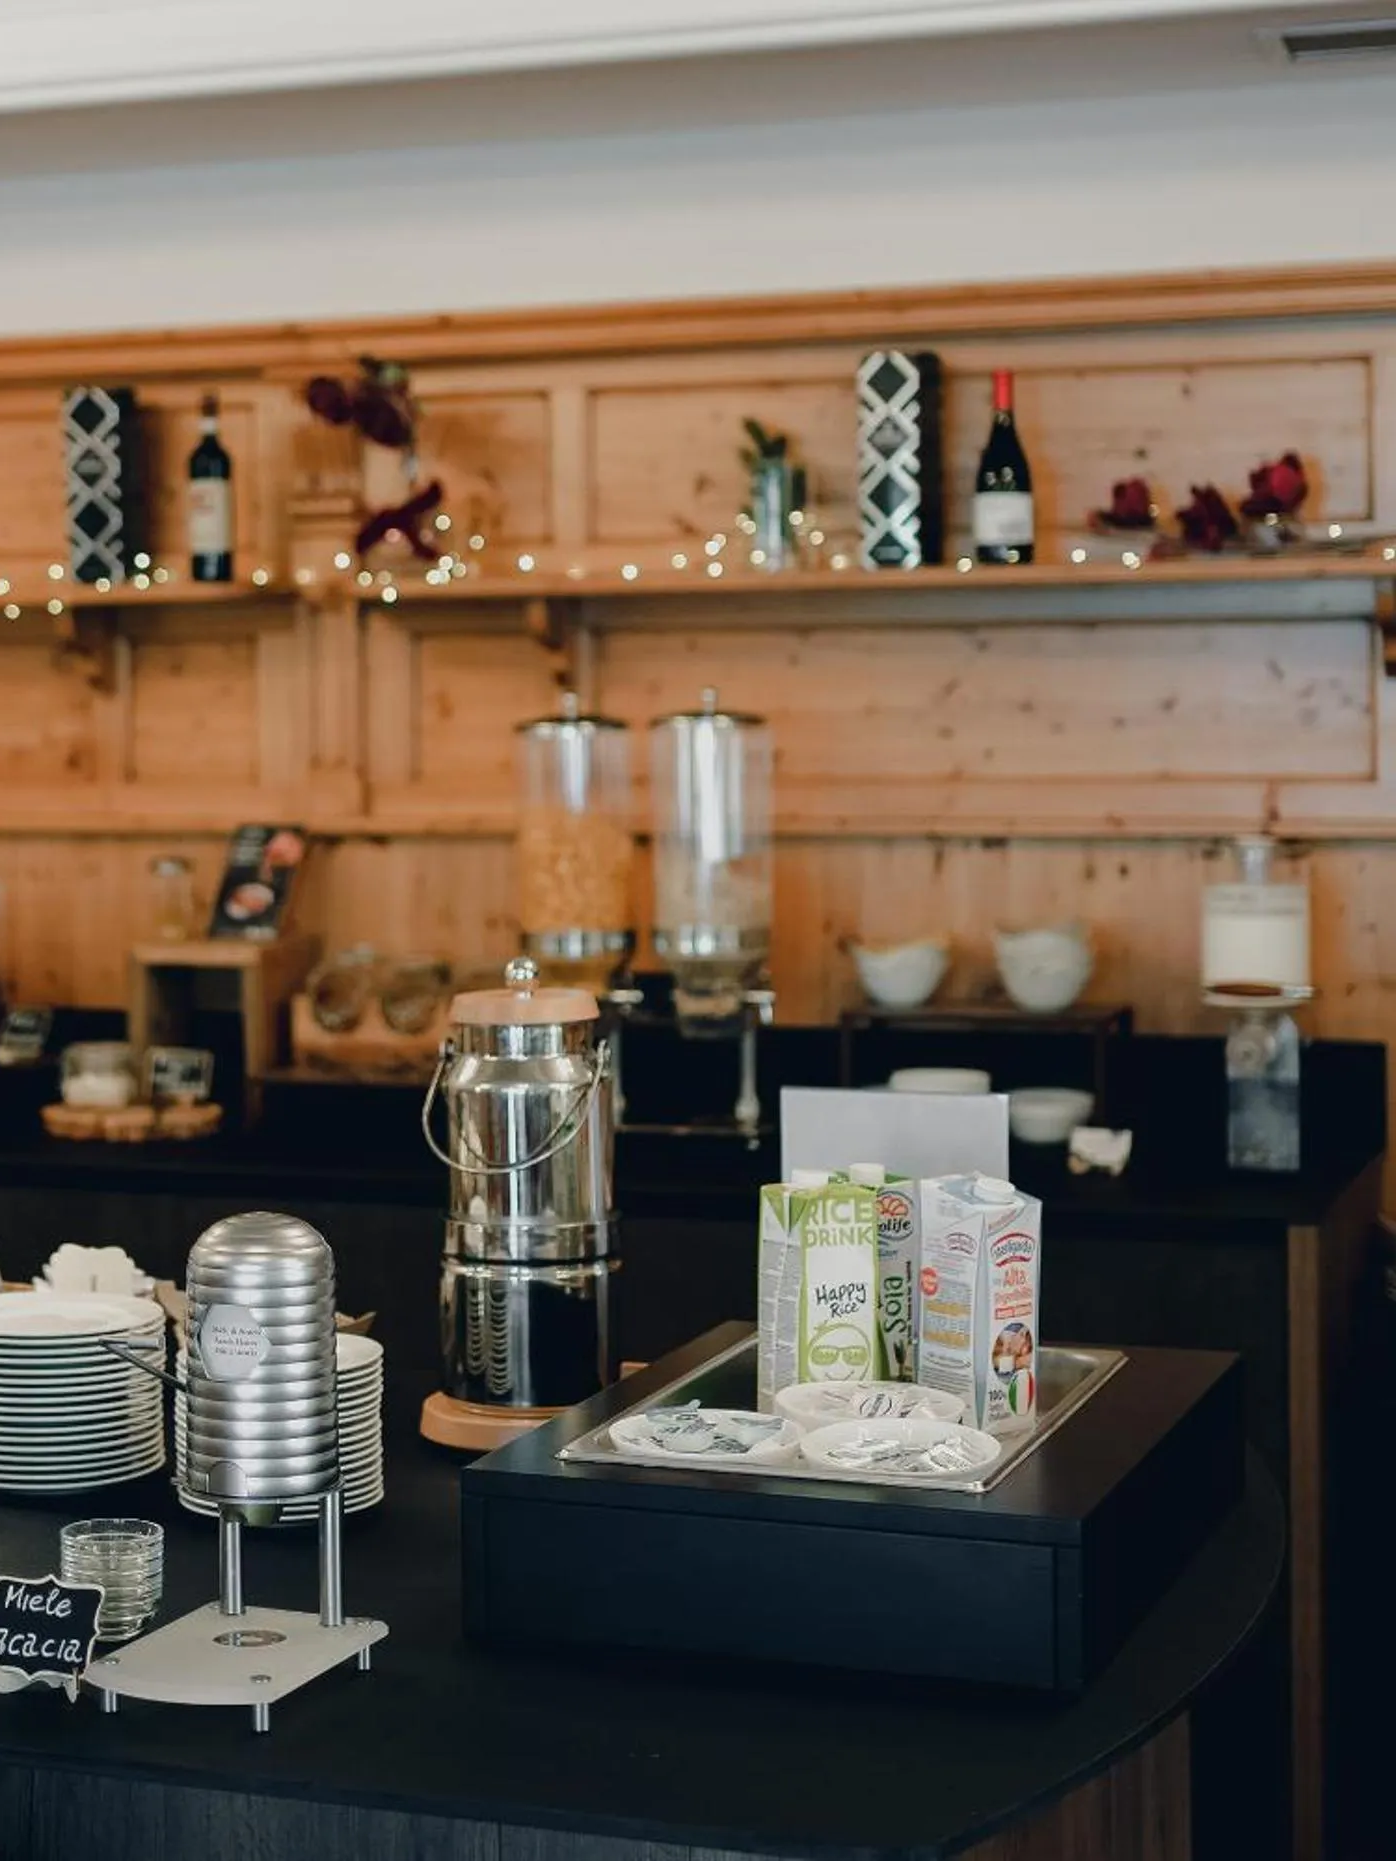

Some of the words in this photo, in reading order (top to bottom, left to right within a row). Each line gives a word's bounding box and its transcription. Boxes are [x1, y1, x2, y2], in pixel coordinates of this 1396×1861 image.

[805, 1199, 874, 1224] RICE
[815, 1282, 866, 1305] Happy
[830, 1302, 860, 1318] Rice
[4, 1584, 72, 1618] Miele
